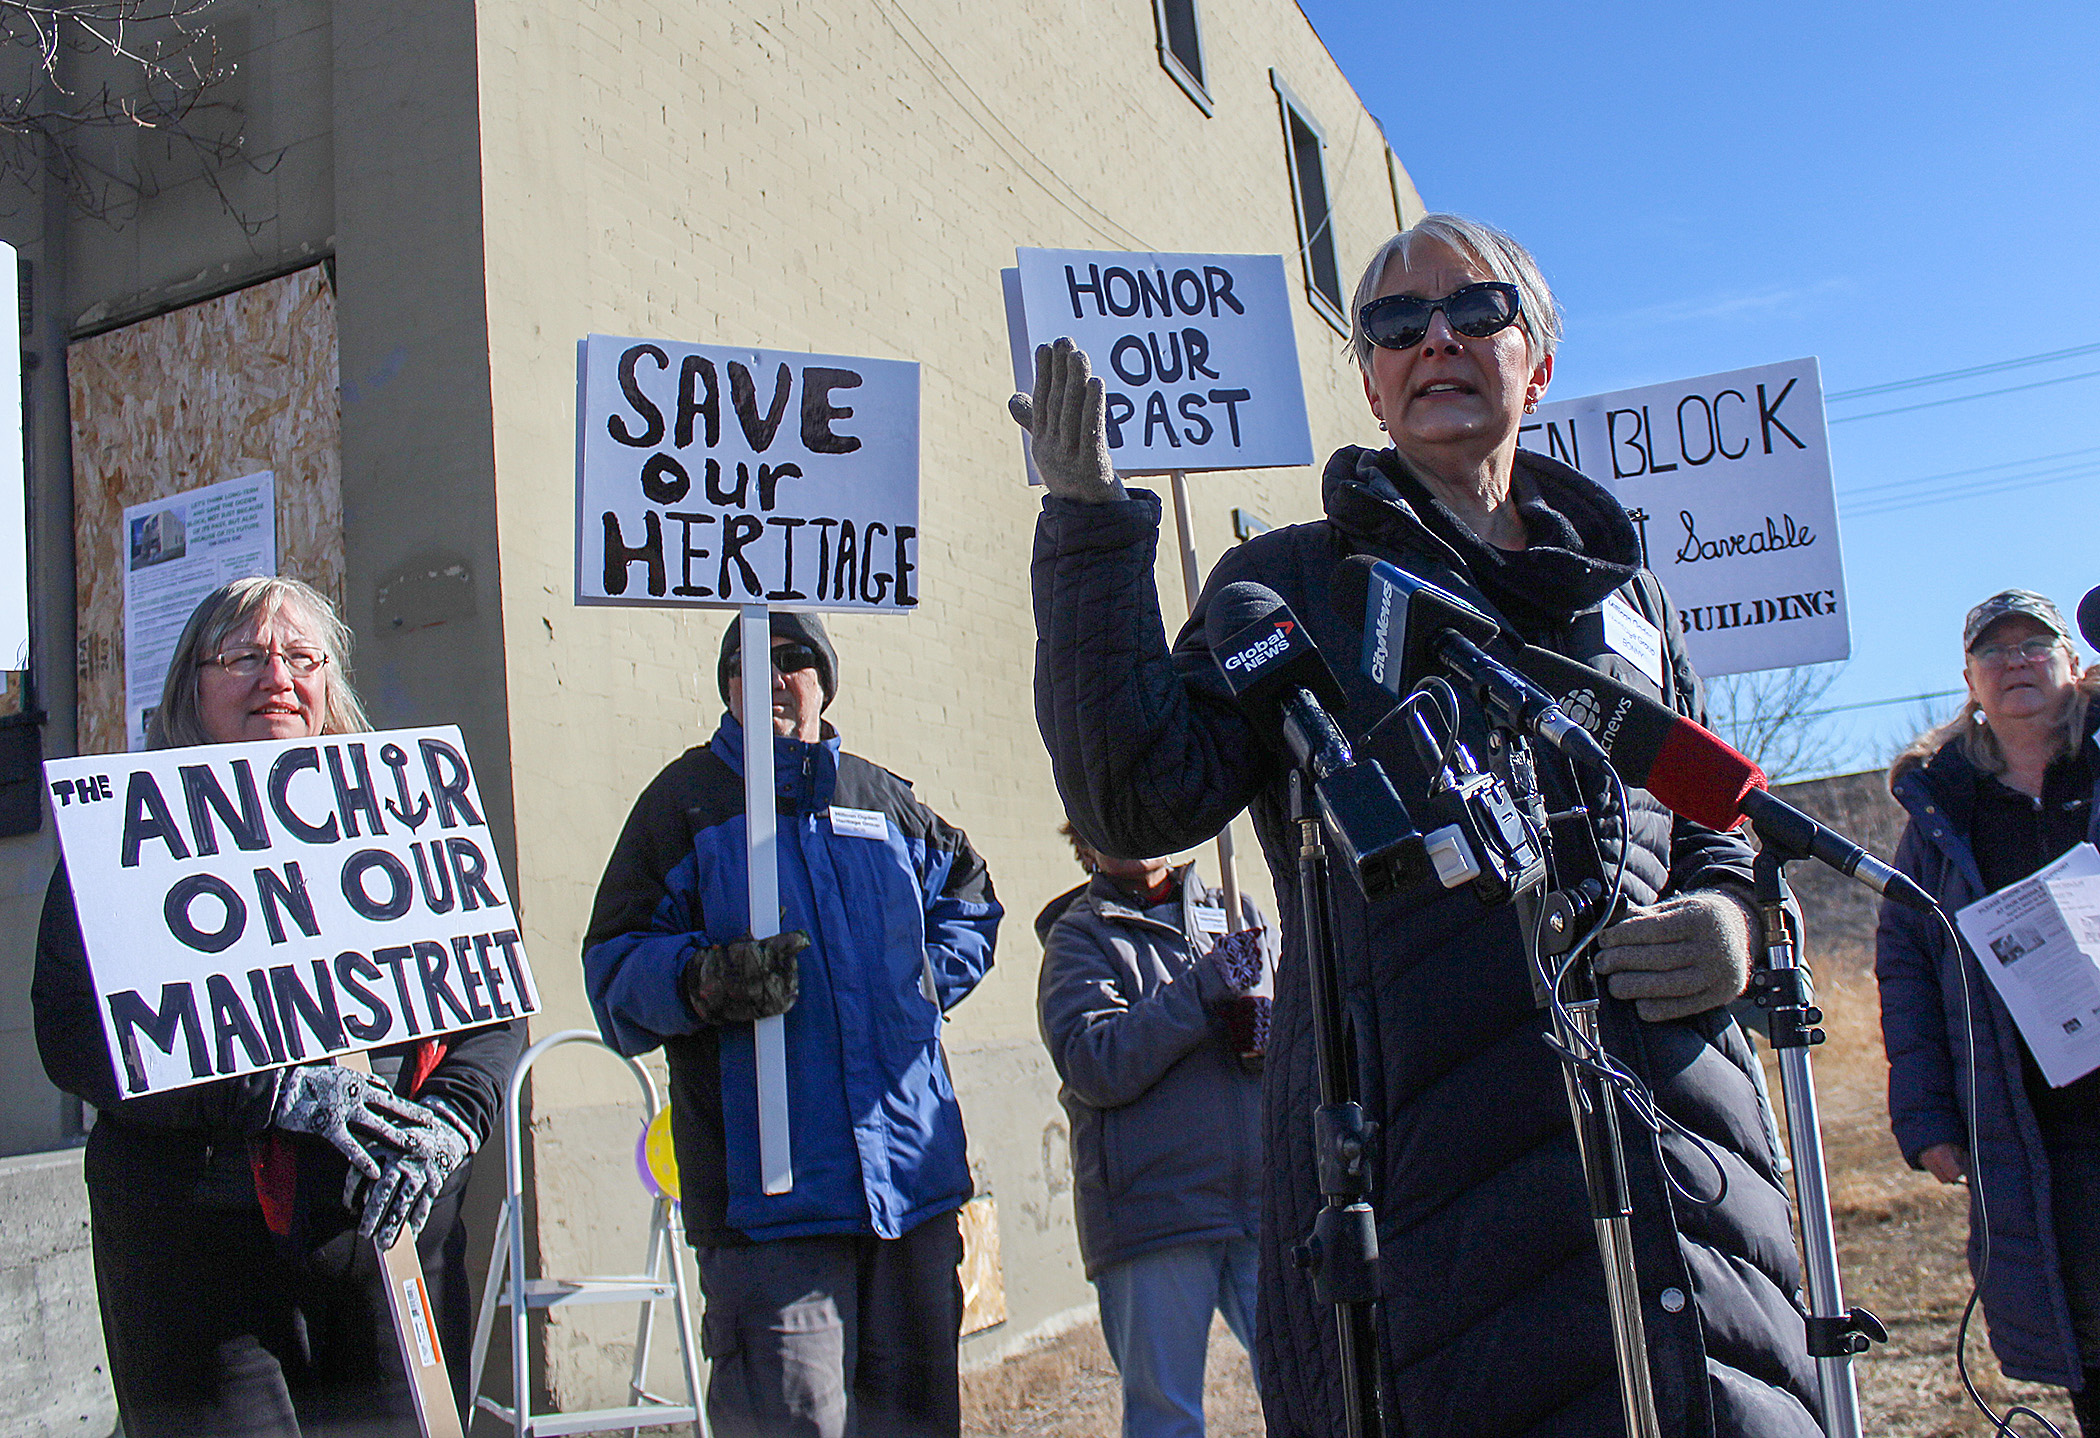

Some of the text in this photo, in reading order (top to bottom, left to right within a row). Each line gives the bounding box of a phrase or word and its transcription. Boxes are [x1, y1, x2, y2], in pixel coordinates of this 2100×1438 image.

[1065, 263, 1245, 318] HONOR
[1110, 327, 1219, 386] OUR
[607, 343, 863, 454] SAVE
[1105, 388, 1251, 449] PAST
[1607, 377, 1807, 479] BLOCK
[641, 452, 803, 511] our
[602, 510, 919, 606] HERITAGE
[1675, 510, 1817, 565] Saveable
[1371, 579, 1394, 684] CityNews
[1679, 590, 1837, 634] BUILDING
[1225, 628, 1285, 670] Global
[1244, 638, 1291, 673] NEWS
[50, 774, 113, 807] THE
[164, 838, 506, 953] ON OUR
[106, 929, 535, 1093] MAINSTREET
